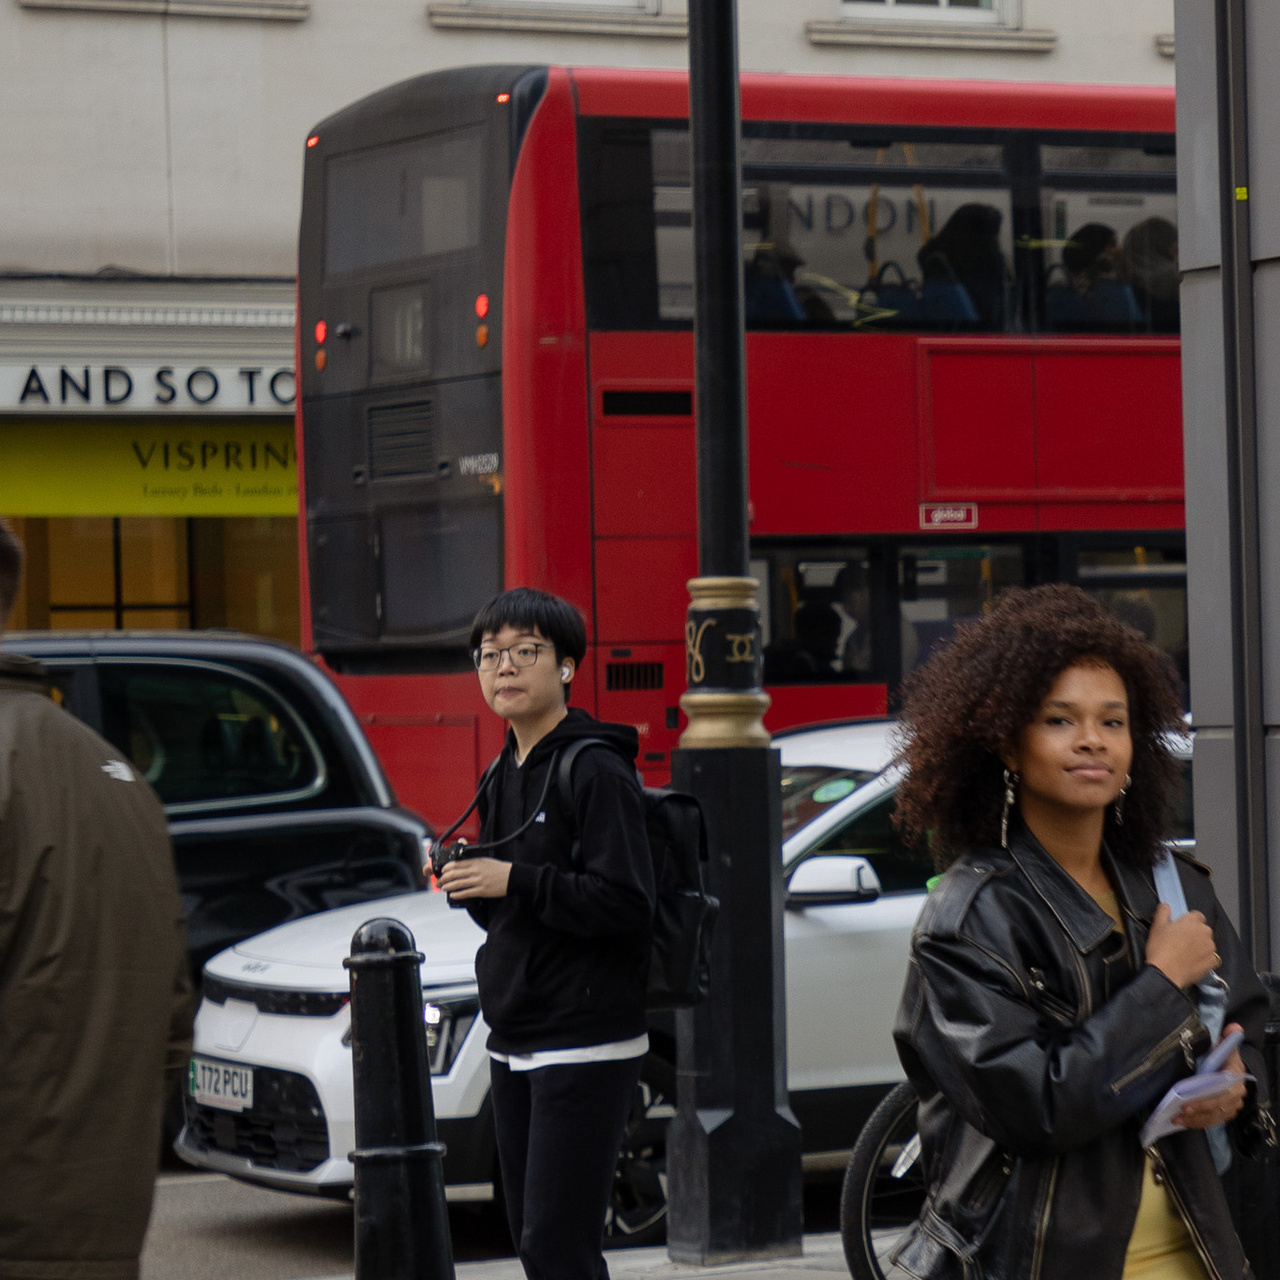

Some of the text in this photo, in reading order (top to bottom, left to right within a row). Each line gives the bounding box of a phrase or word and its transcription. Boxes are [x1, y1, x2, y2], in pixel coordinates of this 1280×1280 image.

[787, 192, 936, 234] NDON
[19, 365, 297, 406] AND SO TO
[131, 439, 297, 471] VISPRIN
[223, 1069, 249, 1098] PCU
